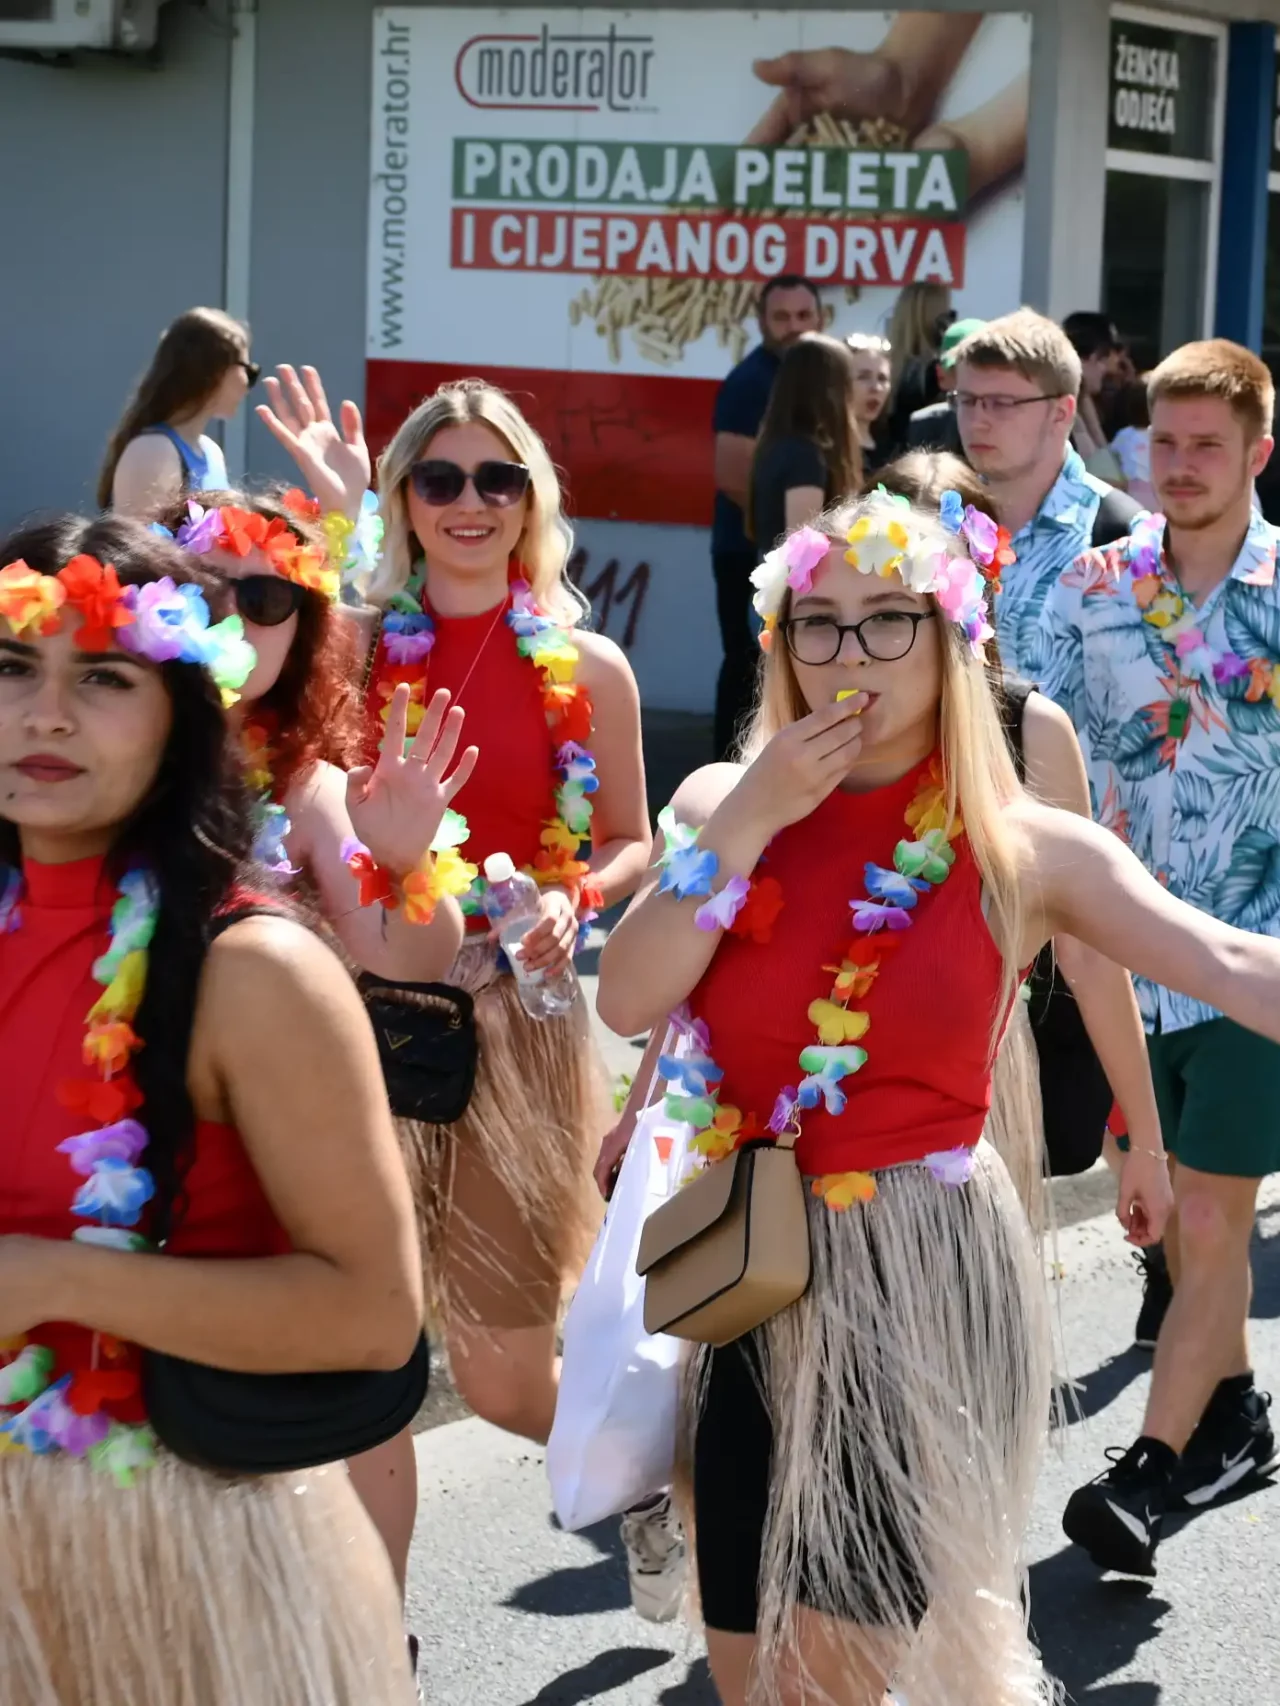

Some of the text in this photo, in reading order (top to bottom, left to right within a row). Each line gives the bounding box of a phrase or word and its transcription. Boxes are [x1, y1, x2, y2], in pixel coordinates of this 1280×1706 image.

[477, 22, 655, 111] moderator
[1115, 34, 1179, 90] ŽENSKA
[1115, 87, 1176, 134] ODJEĆA
[381, 20, 411, 350] www.moderator.hr
[461, 142, 958, 211] PRODAJA PELETA
[461, 216, 953, 283] I CIJEPANOG DRVA
